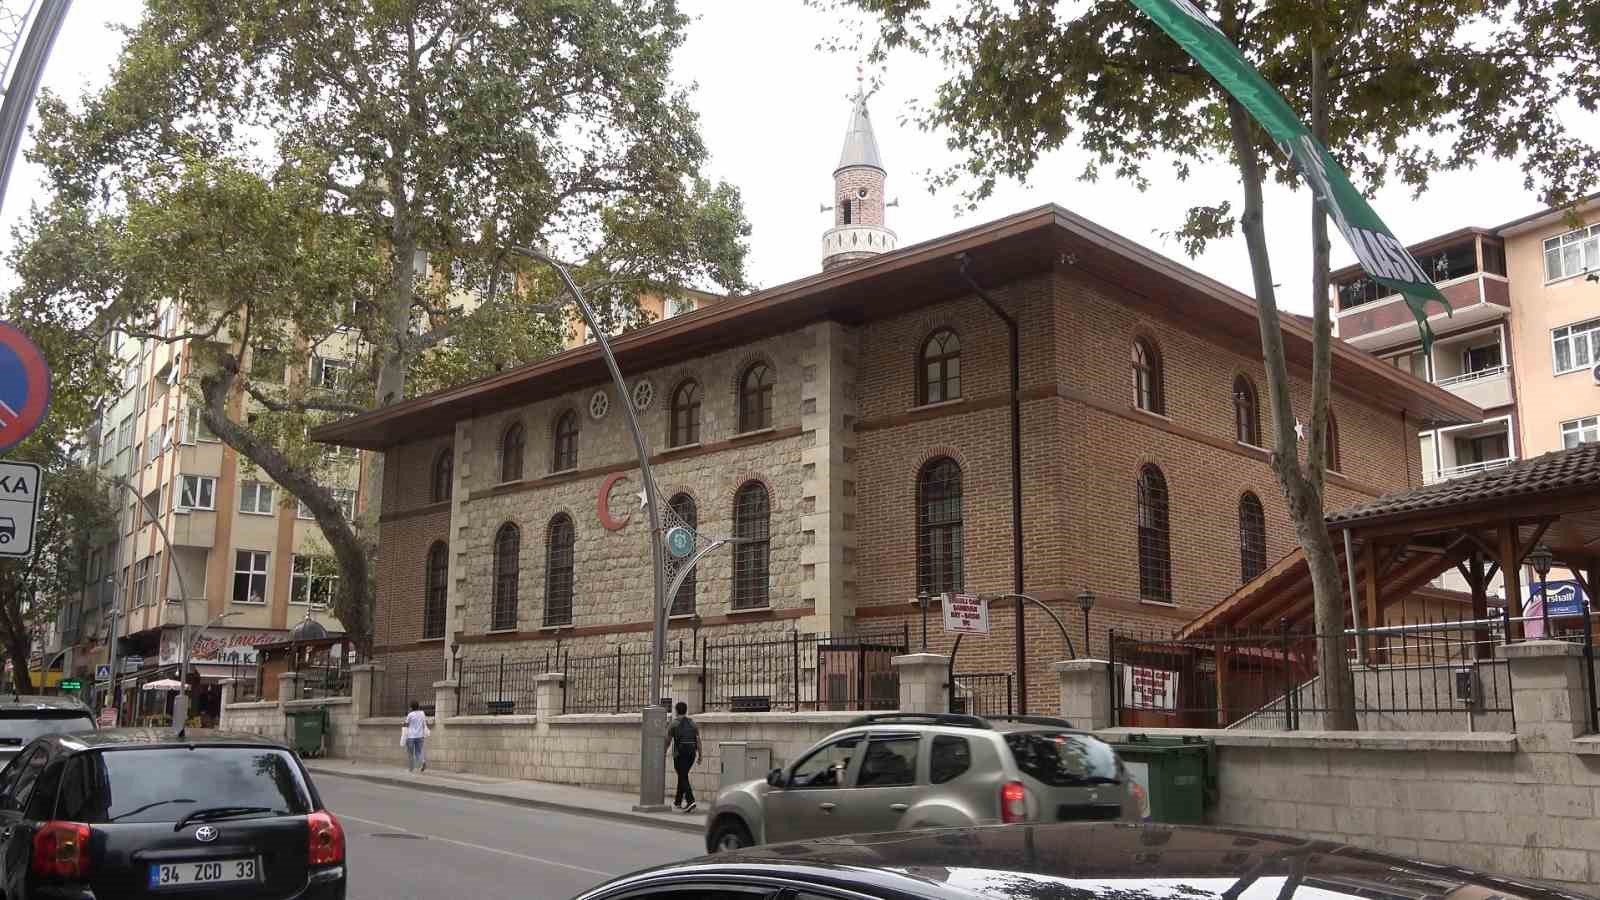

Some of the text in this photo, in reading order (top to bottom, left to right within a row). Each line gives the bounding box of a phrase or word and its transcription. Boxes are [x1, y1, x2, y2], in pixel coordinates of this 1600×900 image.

[1533, 593, 1575, 603] Mrshall
[161, 861, 254, 883] 34 ZCD 33
